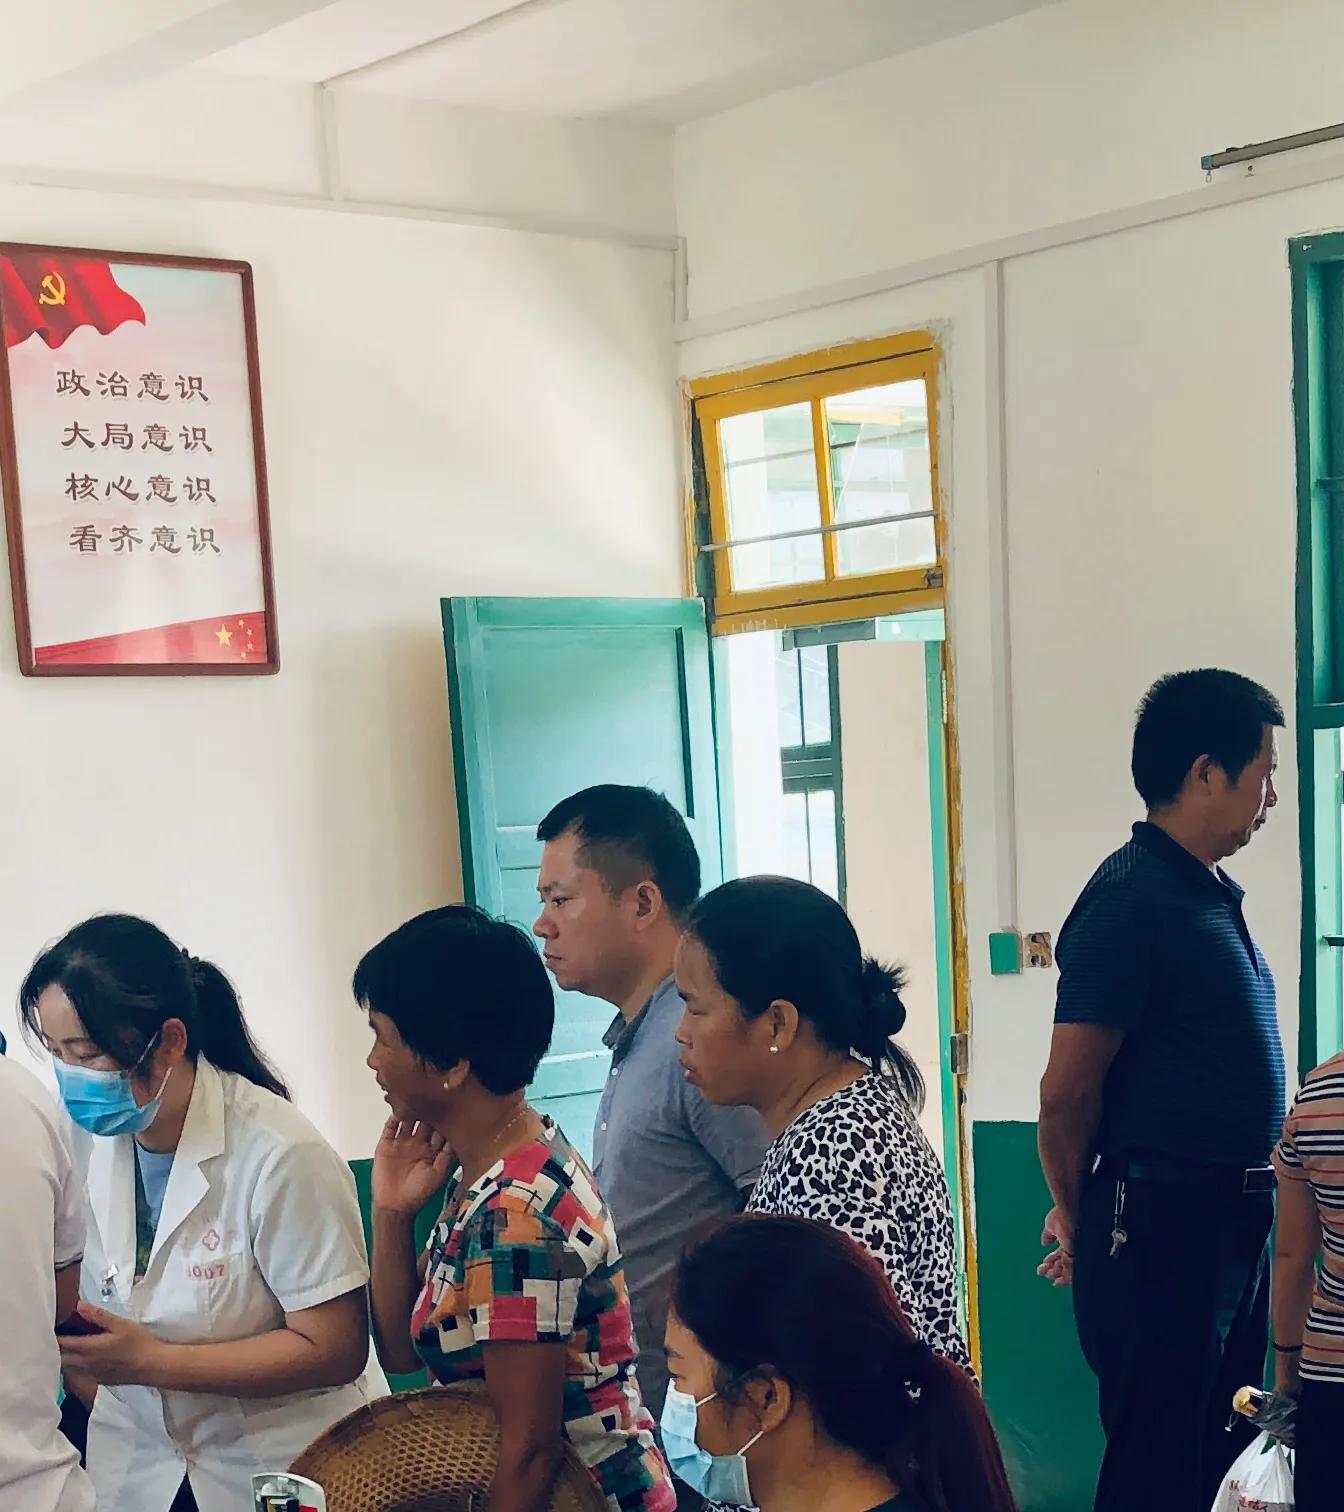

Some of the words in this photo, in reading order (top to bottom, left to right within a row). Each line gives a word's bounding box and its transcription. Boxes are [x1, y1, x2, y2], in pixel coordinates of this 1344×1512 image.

[55, 368, 210, 402] 政治意识
[60, 420, 213, 454] 大局意识
[65, 472, 217, 504] 核心意识
[69, 524, 221, 555] 看齐意识
